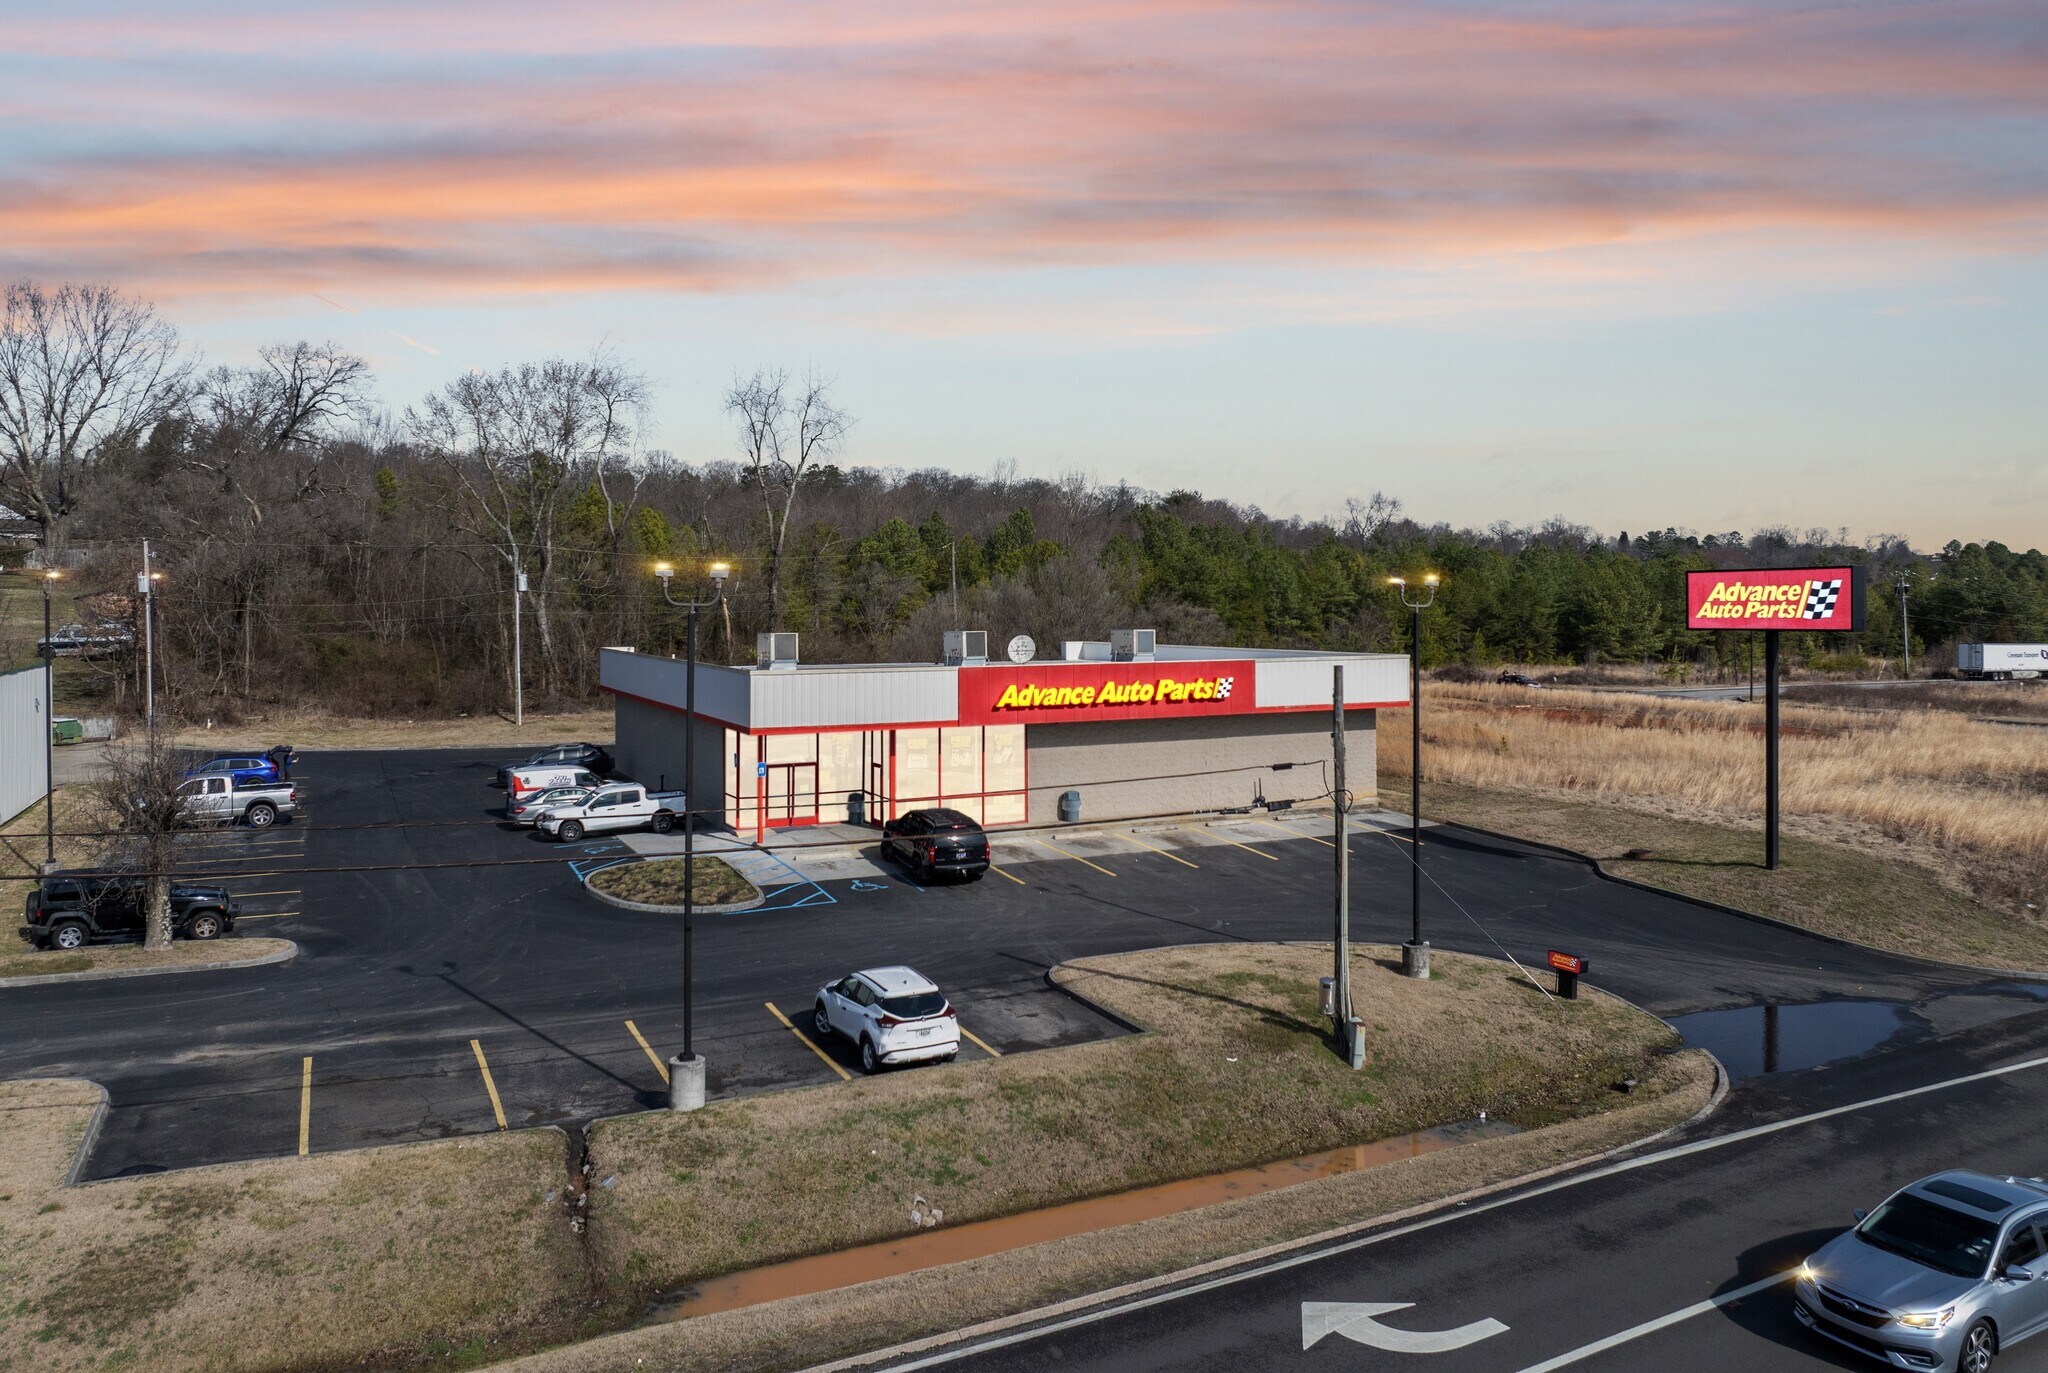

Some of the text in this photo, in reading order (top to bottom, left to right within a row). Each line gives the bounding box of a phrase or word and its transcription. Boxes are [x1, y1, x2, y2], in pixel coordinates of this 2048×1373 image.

[1707, 582, 1802, 602] Advance
[1696, 602, 1797, 619] Auto Parts
[997, 678, 1214, 708] Advance Auto Parts
